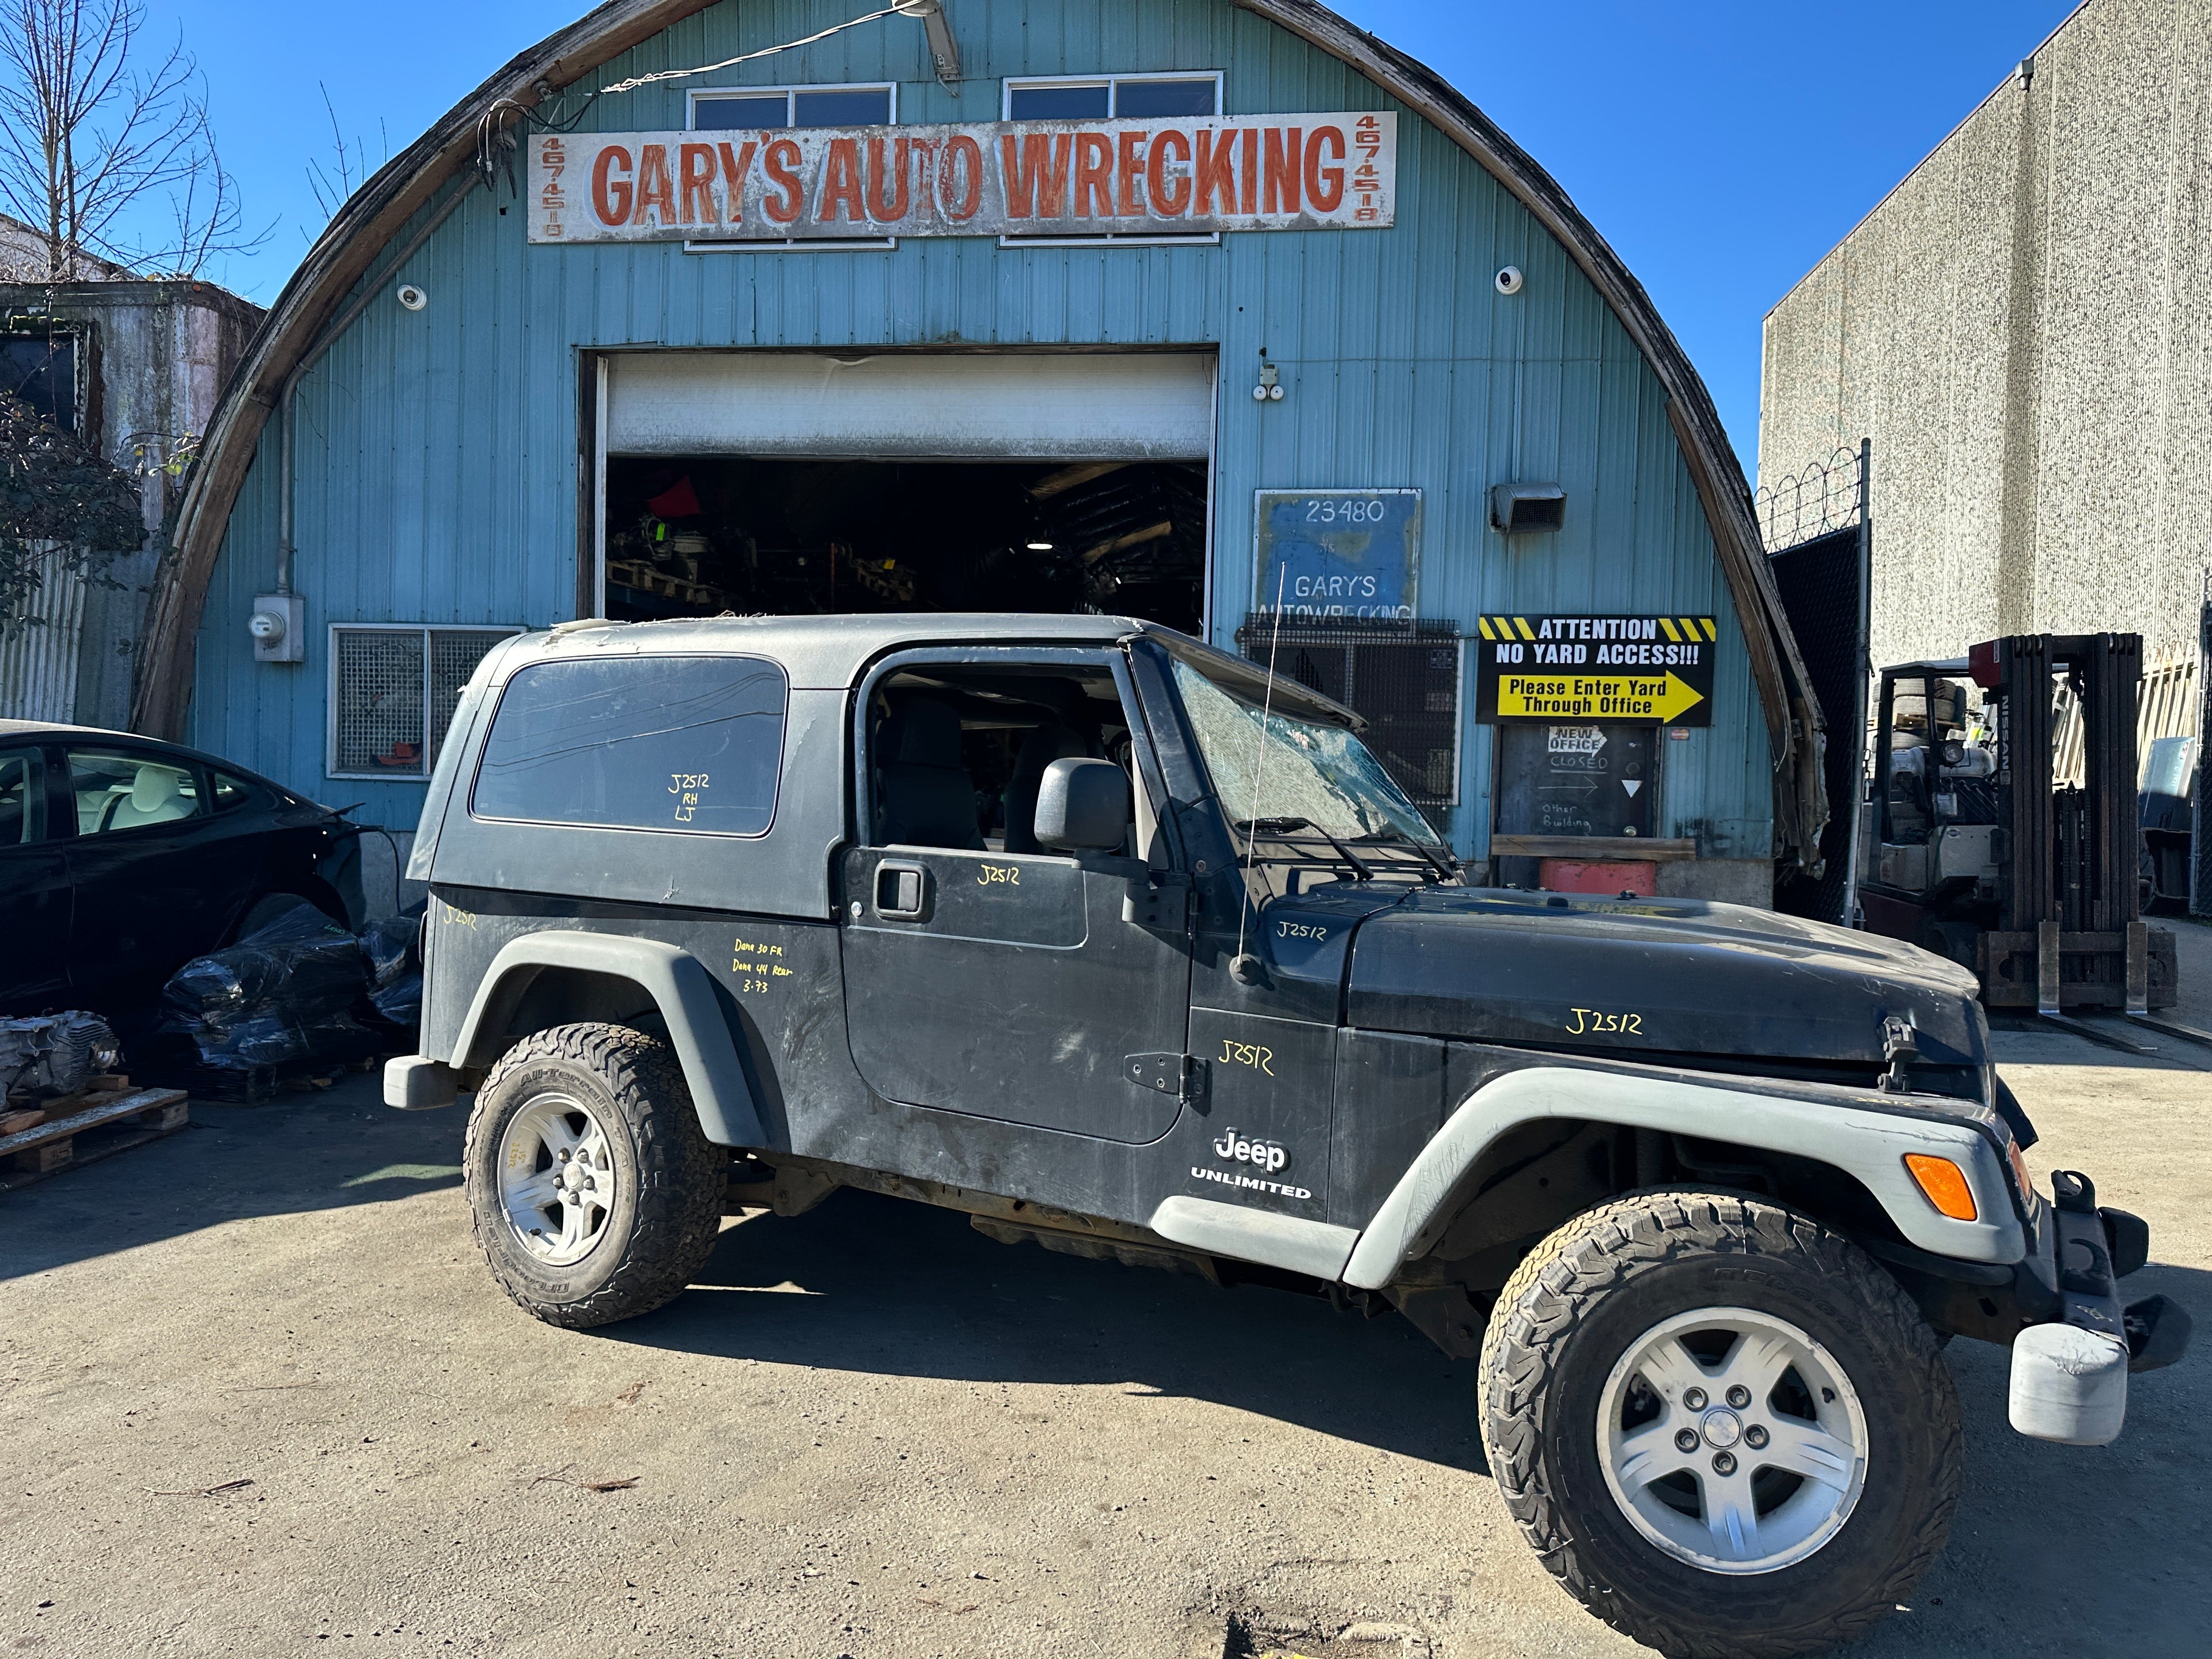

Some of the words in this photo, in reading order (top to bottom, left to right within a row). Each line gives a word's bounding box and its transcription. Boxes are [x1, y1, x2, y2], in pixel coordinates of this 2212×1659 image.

[592, 132, 802, 226] GARY'S
[819, 135, 981, 222] AUTO
[1001, 126, 1346, 218] WRECKING
[1306, 500, 1384, 522] 23480
[1295, 576, 1376, 597] GARY'S
[1539, 619, 1656, 639] ATTENTION
[1497, 644, 1524, 663] NO
[1533, 644, 1587, 664] YARD
[1596, 645, 1699, 665] ACCESS!!!
[1510, 679, 1566, 695] Please
[1574, 680, 1620, 695] Enter
[1628, 680, 1666, 696] Yard
[1522, 697, 1591, 715] Through
[1600, 698, 1652, 714] Office
[1557, 728, 1592, 738] NEW
[1550, 738, 1600, 749] OFFICE
[1551, 756, 1608, 769] CLOSED
[668, 774, 710, 794] J2512
[683, 793, 698, 805] RH
[675, 805, 696, 822] LJ
[977, 864, 1020, 885] J2512
[1277, 921, 1327, 942] J2512
[734, 938, 755, 952] Dana
[756, 943, 768, 954] 30
[769, 945, 782, 957] FR
[732, 958, 752, 972] Dana
[756, 964, 768, 975] 44
[772, 965, 793, 976] Rear
[1565, 1008, 1643, 1035] J2512
[1218, 1039, 1275, 1077] J2512
[520, 1068, 613, 1119] All-Terrain
[1214, 1128, 1290, 1174] Jeep
[1191, 1166, 1312, 1199] UNLIMITED
